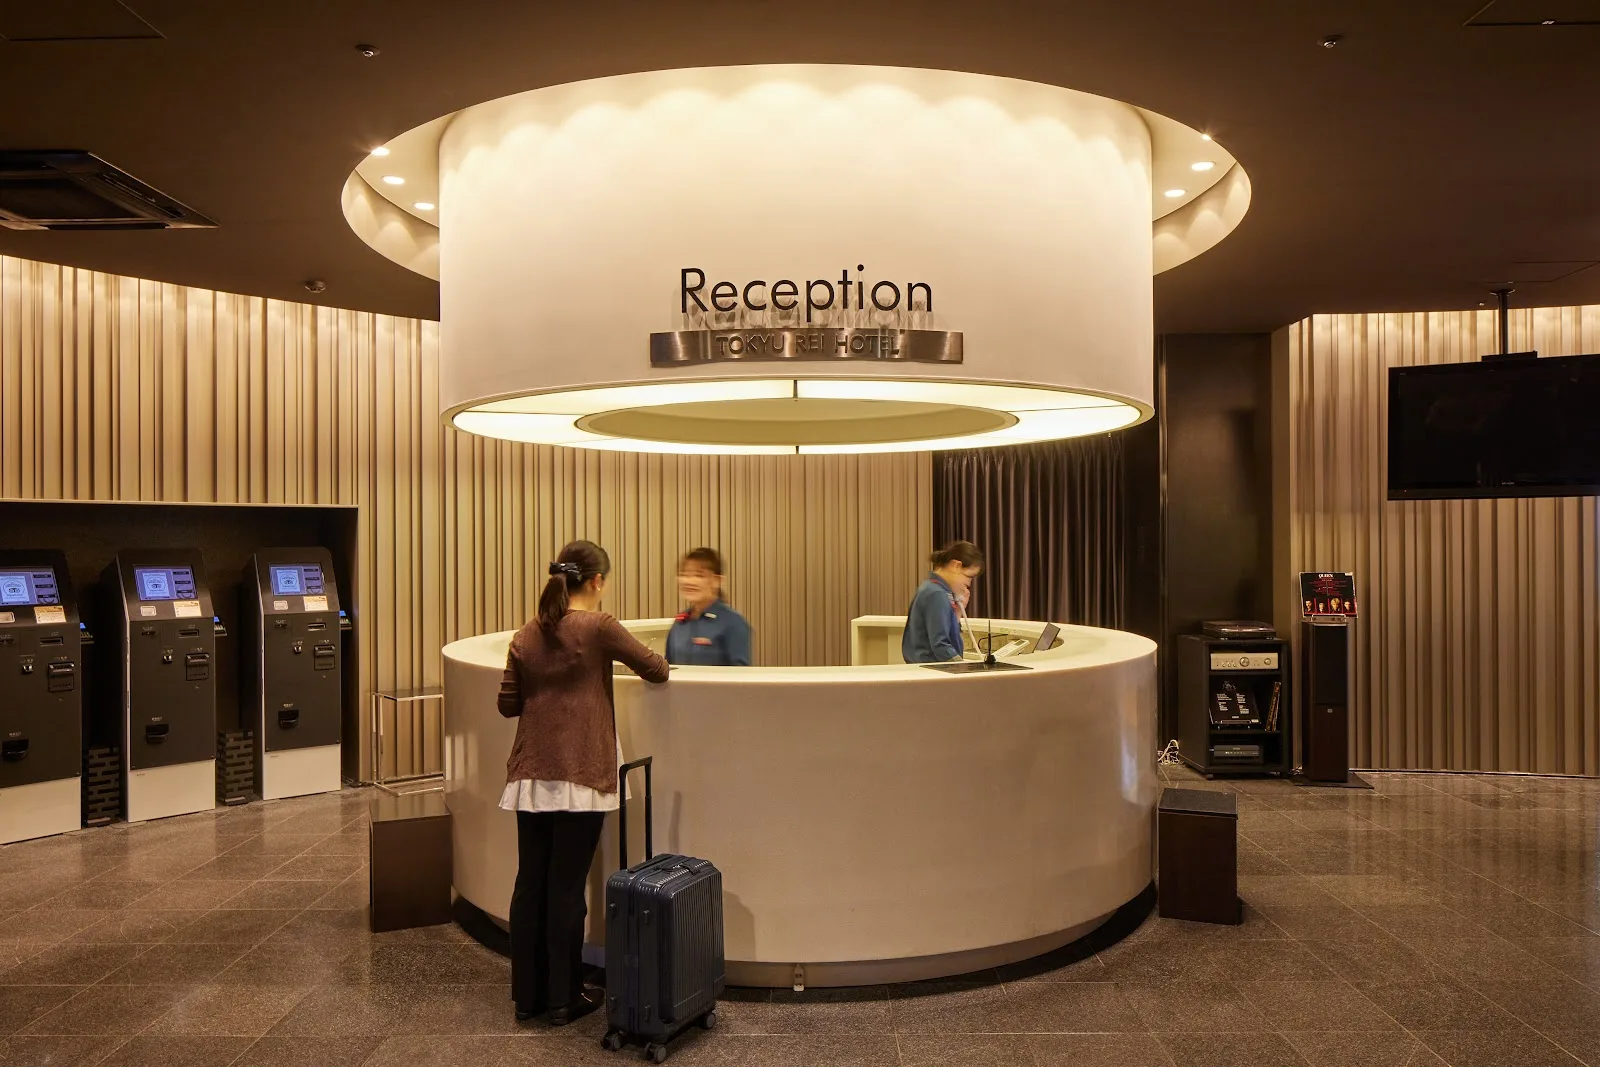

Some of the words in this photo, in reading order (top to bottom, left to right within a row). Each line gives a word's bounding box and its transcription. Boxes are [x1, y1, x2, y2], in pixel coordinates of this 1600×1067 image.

[681, 264, 933, 322] Reception
[715, 333, 785, 355] TOKYU
[795, 333, 825, 354] REI
[834, 333, 901, 356] HOTEL
